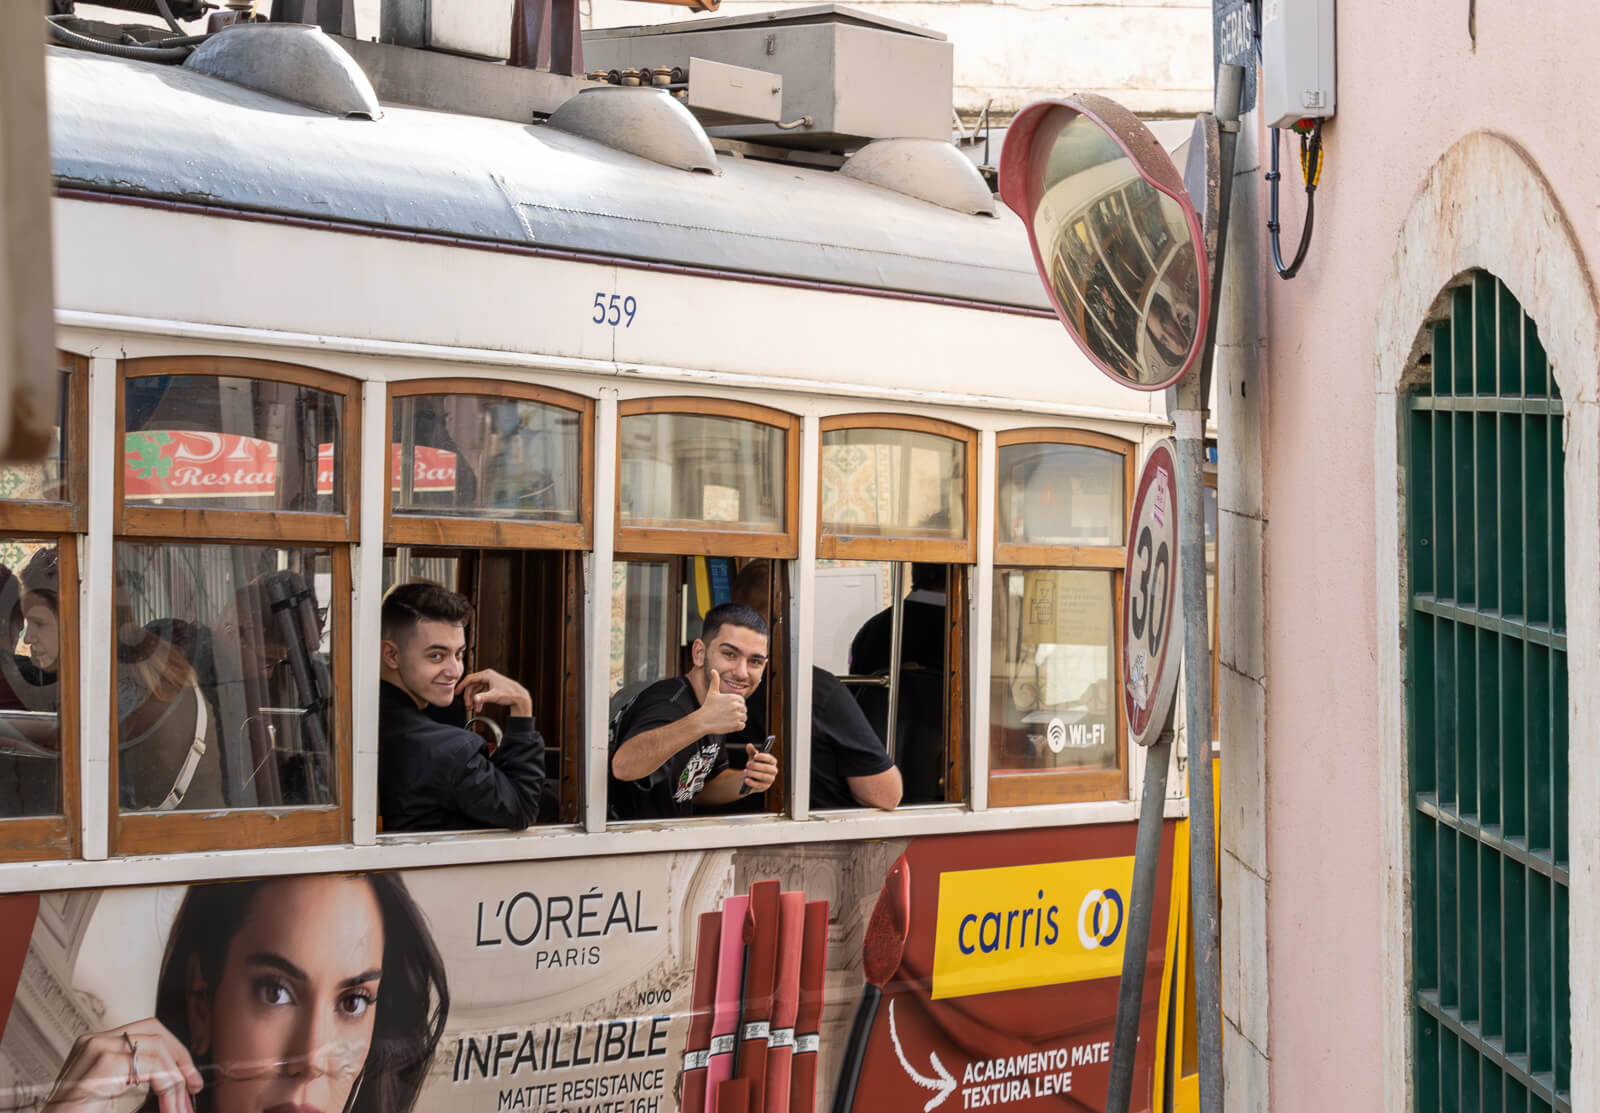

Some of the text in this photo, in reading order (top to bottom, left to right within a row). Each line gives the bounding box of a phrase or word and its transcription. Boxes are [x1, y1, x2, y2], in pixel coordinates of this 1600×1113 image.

[1220, 2, 1251, 64] GERAIS
[592, 292, 637, 328] 559
[1132, 525, 1169, 658] 30
[1069, 723, 1105, 745] WI-FI
[475, 886, 658, 947] L'ORÉAL
[958, 889, 1059, 955] carris
[637, 989, 672, 1006] NOVO
[452, 1015, 671, 1082] INFAILLIBLE
[962, 1042, 1111, 1084] ACABAMENTO MATE
[498, 1069, 665, 1111] MATTE RESISTANCE
[962, 1072, 1072, 1109] TEXTURA LEVE
